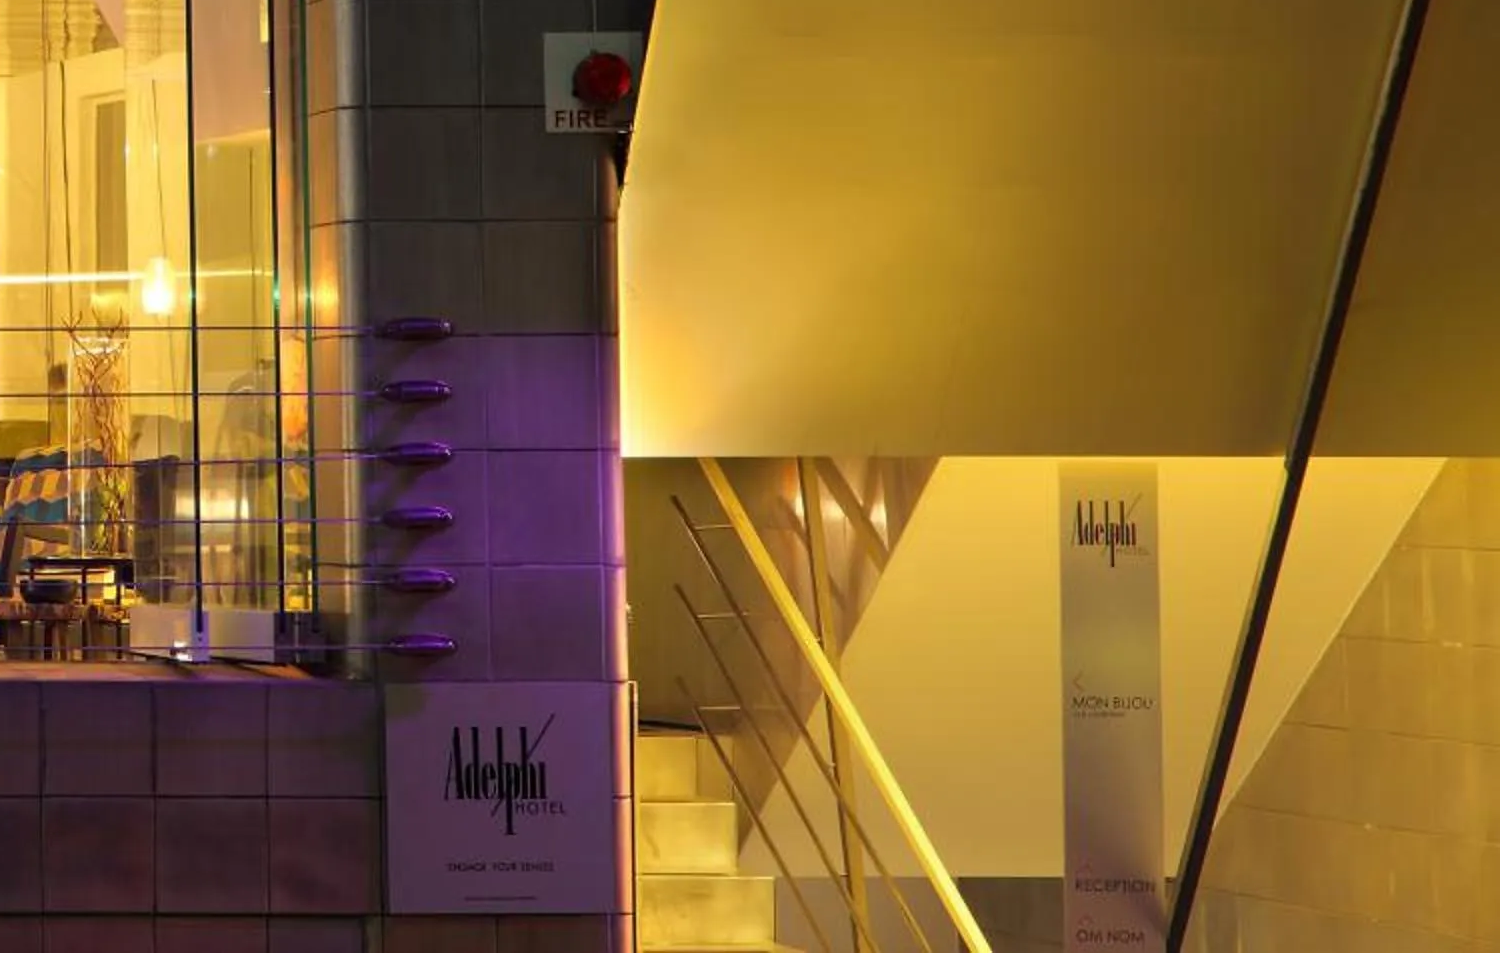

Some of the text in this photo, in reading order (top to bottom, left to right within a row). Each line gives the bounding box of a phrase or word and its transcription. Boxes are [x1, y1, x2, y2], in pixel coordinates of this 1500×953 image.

[554, 109, 609, 128] FIRE
[1071, 499, 1137, 568] Adelphi
[1073, 696, 1109, 709] MON
[444, 726, 548, 836] Adelphi
[515, 801, 567, 815] HOTEL
[1075, 878, 1156, 892] RECEPTION
